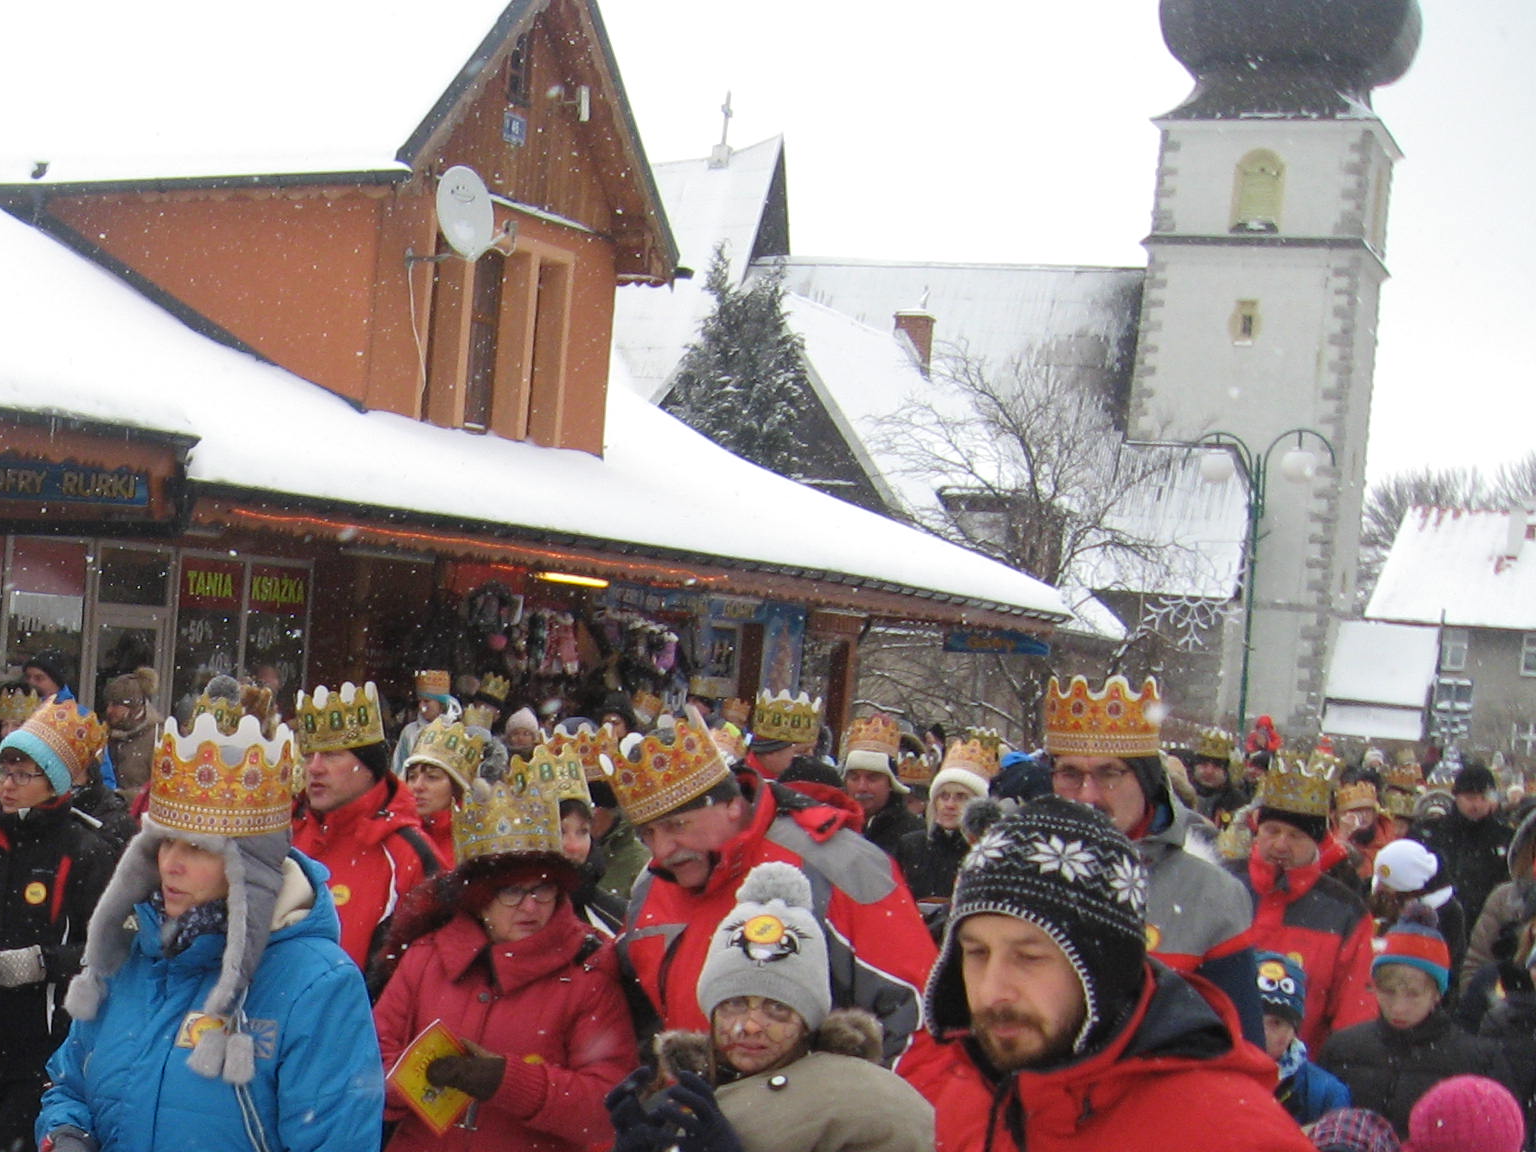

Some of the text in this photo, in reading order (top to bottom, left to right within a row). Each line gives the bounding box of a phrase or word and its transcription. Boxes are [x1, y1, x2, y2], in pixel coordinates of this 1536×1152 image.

[62, 470, 137, 499] RURKI
[187, 570, 233, 598] TANIA
[251, 572, 305, 608] KSIĄŻKA
